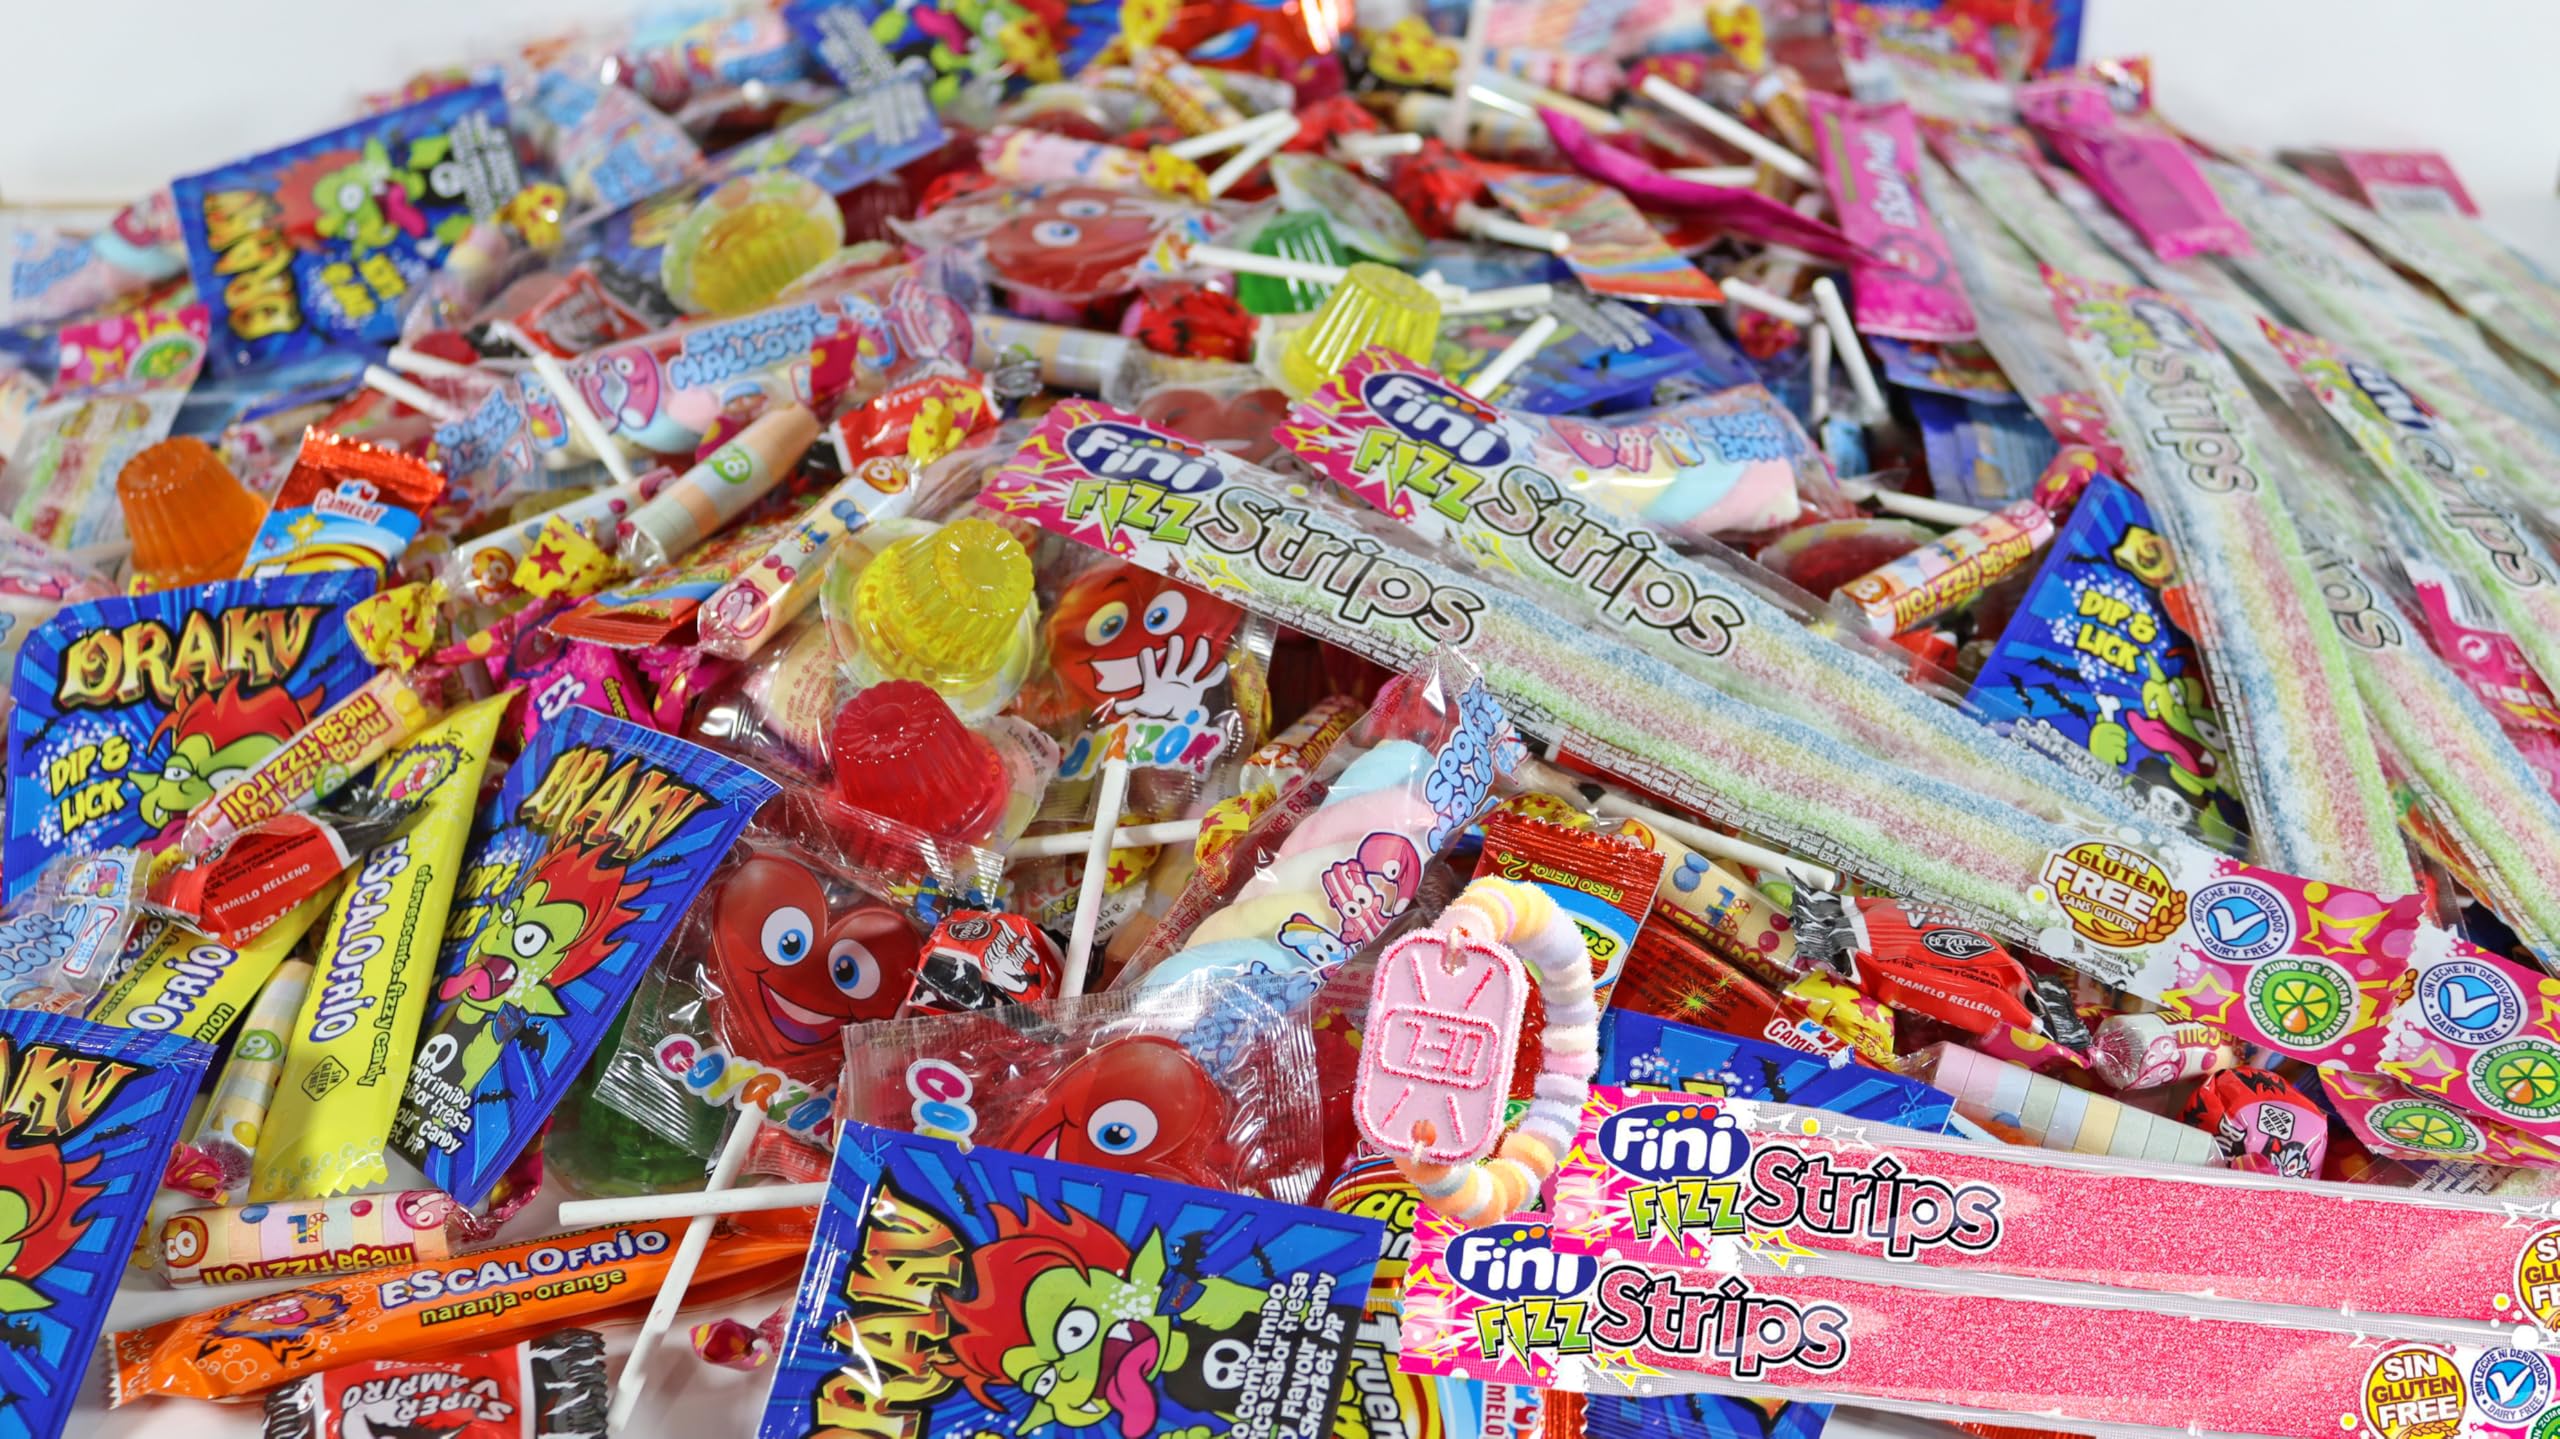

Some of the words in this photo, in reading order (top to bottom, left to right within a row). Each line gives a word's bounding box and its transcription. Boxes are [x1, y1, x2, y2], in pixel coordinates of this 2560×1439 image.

[1372, 377, 1503, 464] Fini
[2129, 351, 2258, 494] Strips
[1076, 429, 1212, 492] Fini
[1064, 480, 1204, 545] FIZZ
[1196, 487, 1484, 645] Strips
[1354, 428, 1487, 522] FIZZ
[1475, 466, 1746, 656] Strips
[2078, 589, 2132, 627] DIP
[2128, 612, 2157, 644] &
[2077, 622, 2141, 673] LICK
[314, 692, 378, 744] mega
[49, 750, 94, 796] DIP
[98, 734, 132, 772] &
[58, 778, 127, 836] LICK
[1531, 863, 1580, 888] NETO:
[2076, 848, 2167, 899] GLUTEN
[2101, 845, 2152, 876] SIN
[212, 887, 261, 917] RAMELO
[262, 862, 313, 896] RELLENO
[1579, 878, 1624, 903] PESO
[2045, 854, 2158, 923] FREE
[2199, 885, 2228, 909] LECHE
[2242, 886, 2287, 935] DERIVADOS
[2059, 893, 2093, 914] SANS
[2092, 905, 2139, 934] GLUTEN
[308, 834, 411, 1044] ESCALOFRÍO
[2203, 935, 2240, 959] DAIRY
[2242, 941, 2276, 959] FREE
[1881, 970, 1947, 1001] CARAMELO
[1947, 994, 2002, 1019] RELLENO
[2262, 961, 2300, 979] ZUMO
[2301, 962, 2323, 975] DE
[2320, 968, 2352, 1008] FRUTAS
[2430, 964, 2462, 989] LECHE
[2478, 967, 2516, 1023] DERIVADOS
[2251, 1000, 2282, 1038] JUICE
[2278, 1030, 2324, 1047] FRUIT
[2322, 1010, 2351, 1041] WITH
[2430, 1012, 2466, 1040] DAIRY
[2468, 1028, 2503, 1042] FREE
[2489, 1040, 2529, 1059] ZUMO
[410, 1063, 472, 1111] mprimido
[2474, 1078, 2504, 1108] JUICE
[2503, 1101, 2548, 1118] FRUIT
[418, 1119, 463, 1155] candy
[429, 1097, 473, 1134] fresa
[2260, 1115, 2277, 1134] FREE
[2264, 1107, 2289, 1136] GLUTEN
[2277, 1110, 2292, 1125] SIN
[1612, 1113, 1736, 1174] Fini
[1627, 1177, 1746, 1253] FIZZ
[1744, 1146, 2002, 1258] Strips
[339, 1244, 413, 1272] mega
[380, 1229, 669, 1309] ESCALOFRÍO
[1460, 1237, 1580, 1294] Fini
[420, 1292, 519, 1326] naranja
[535, 1267, 626, 1301] orange
[804, 1183, 966, 1439] RAKU
[1277, 1271, 1310, 1334] fresa
[1303, 1271, 1337, 1332] candy
[1475, 1296, 1594, 1374] FIZZ
[1592, 1265, 1851, 1378] Strips
[2371, 1375, 2459, 1404] GLUTEN
[2382, 1353, 2439, 1382] SIN
[2474, 1353, 2499, 1380] LECHE
[2509, 1348, 2549, 1387] DERIVADOS
[342, 1375, 500, 1410] VAMPIRO
[395, 1396, 514, 1428] SUPER
[2376, 1394, 2461, 1430] FREE
[2486, 1403, 2518, 1421] DAIRY
[2518, 1394, 2544, 1419] FREE
